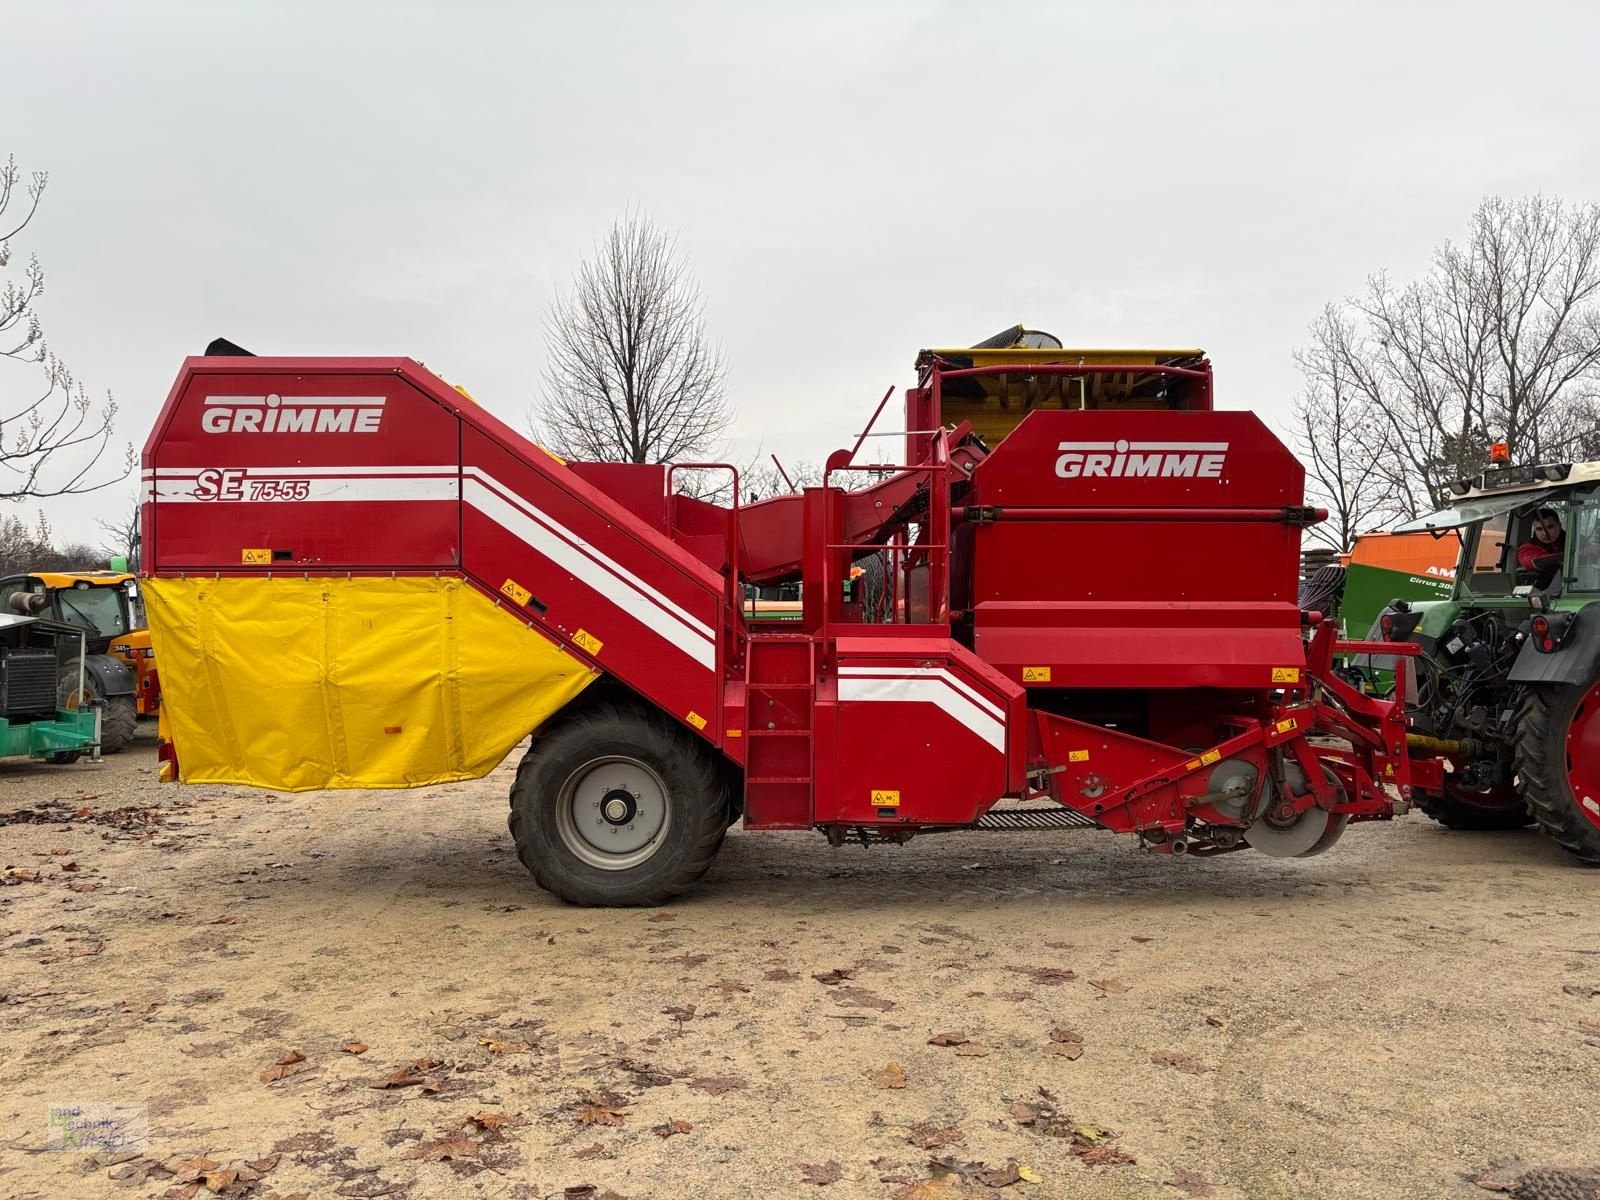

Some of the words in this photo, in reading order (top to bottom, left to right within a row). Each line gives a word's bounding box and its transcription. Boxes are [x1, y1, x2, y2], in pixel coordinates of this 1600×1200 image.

[202, 394, 385, 433] GRIMME
[1055, 440, 1228, 478] GRIMME
[195, 469, 247, 501] SE
[251, 480, 310, 500] 75-55
[1410, 577, 1437, 587] Cirrus
